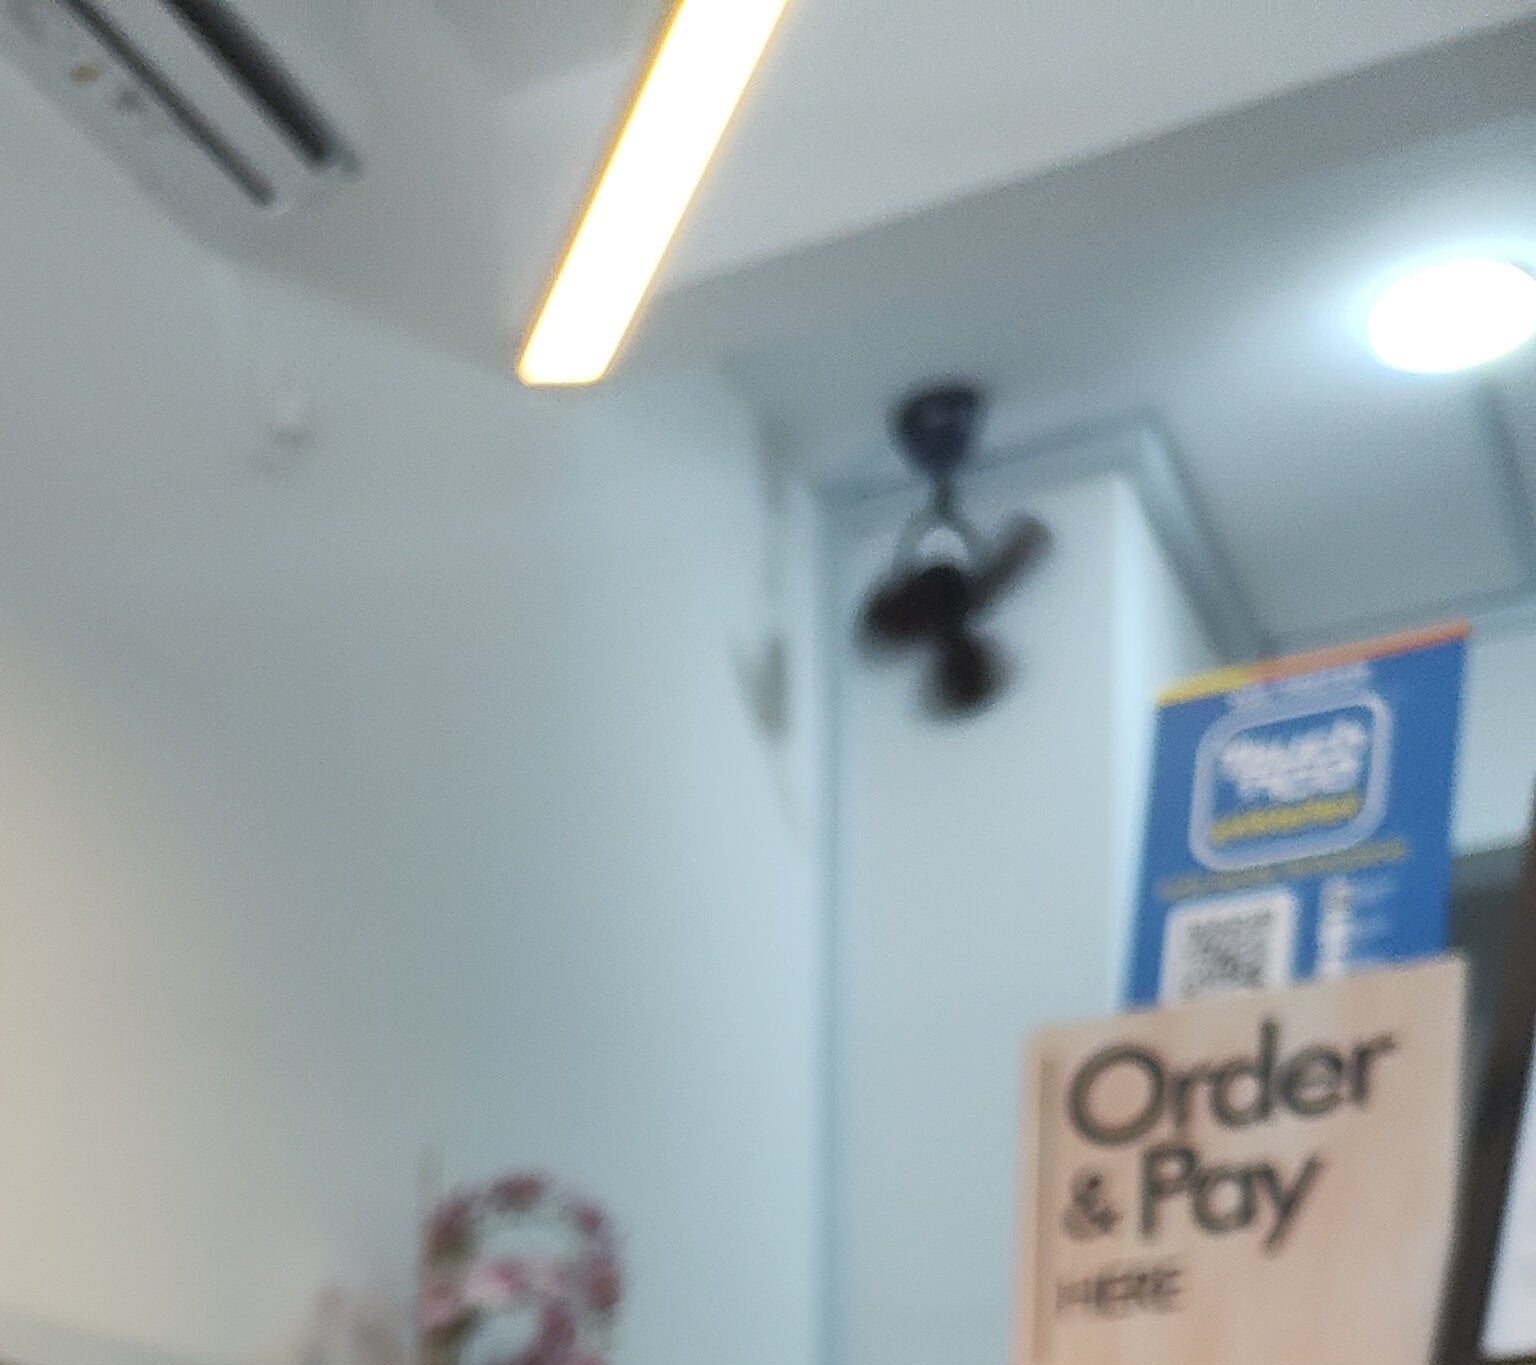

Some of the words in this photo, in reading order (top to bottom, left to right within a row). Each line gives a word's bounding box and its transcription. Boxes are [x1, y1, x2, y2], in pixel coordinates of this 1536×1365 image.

[1067, 1018, 1398, 1146] Order
[1063, 1170, 1120, 1240] &
[1138, 1146, 1322, 1258] Pay
[1057, 1264, 1183, 1318] HERE
